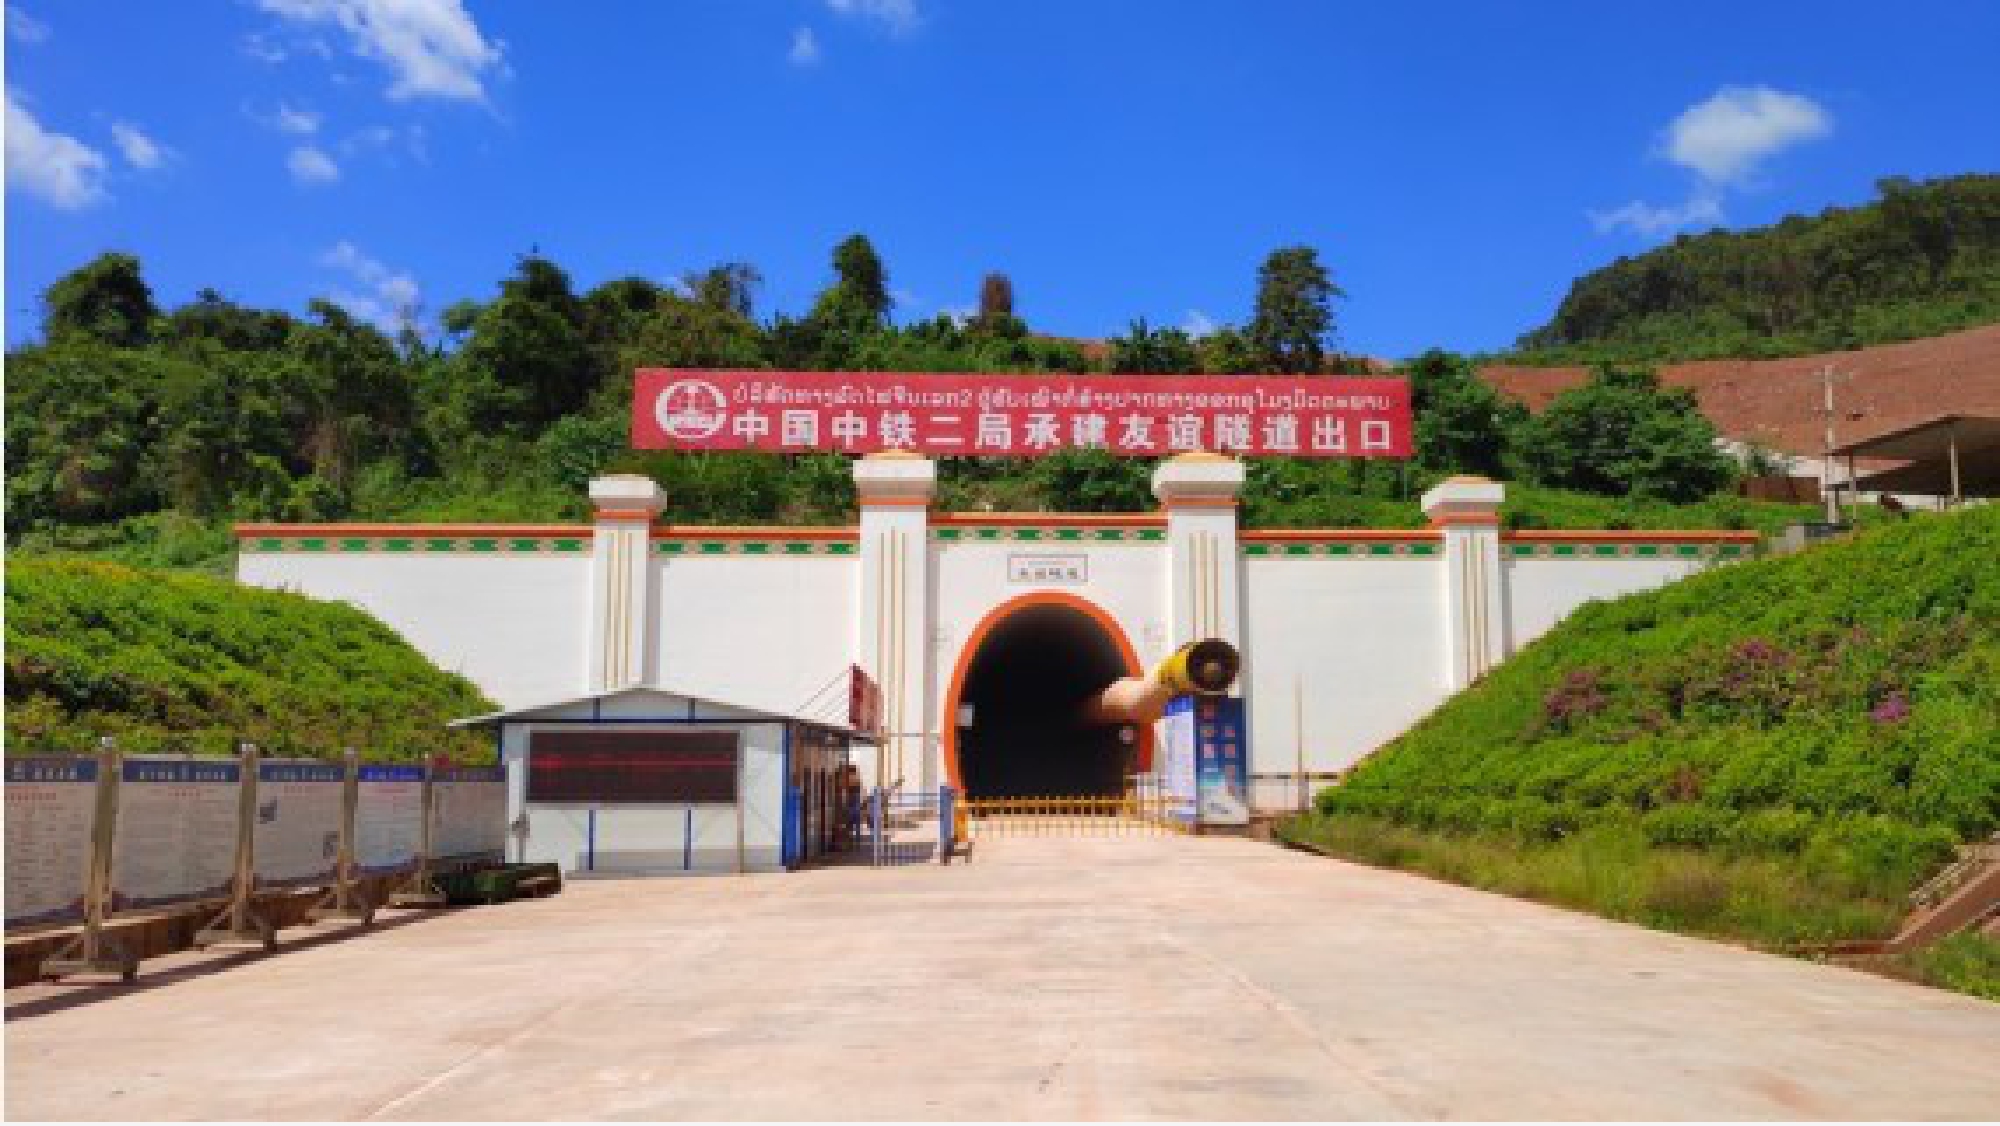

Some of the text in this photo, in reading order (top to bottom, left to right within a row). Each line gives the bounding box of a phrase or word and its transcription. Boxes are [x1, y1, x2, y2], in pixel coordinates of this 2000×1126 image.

[732, 410, 1391, 450] 中国中铁二局承建友谊隧道出口
